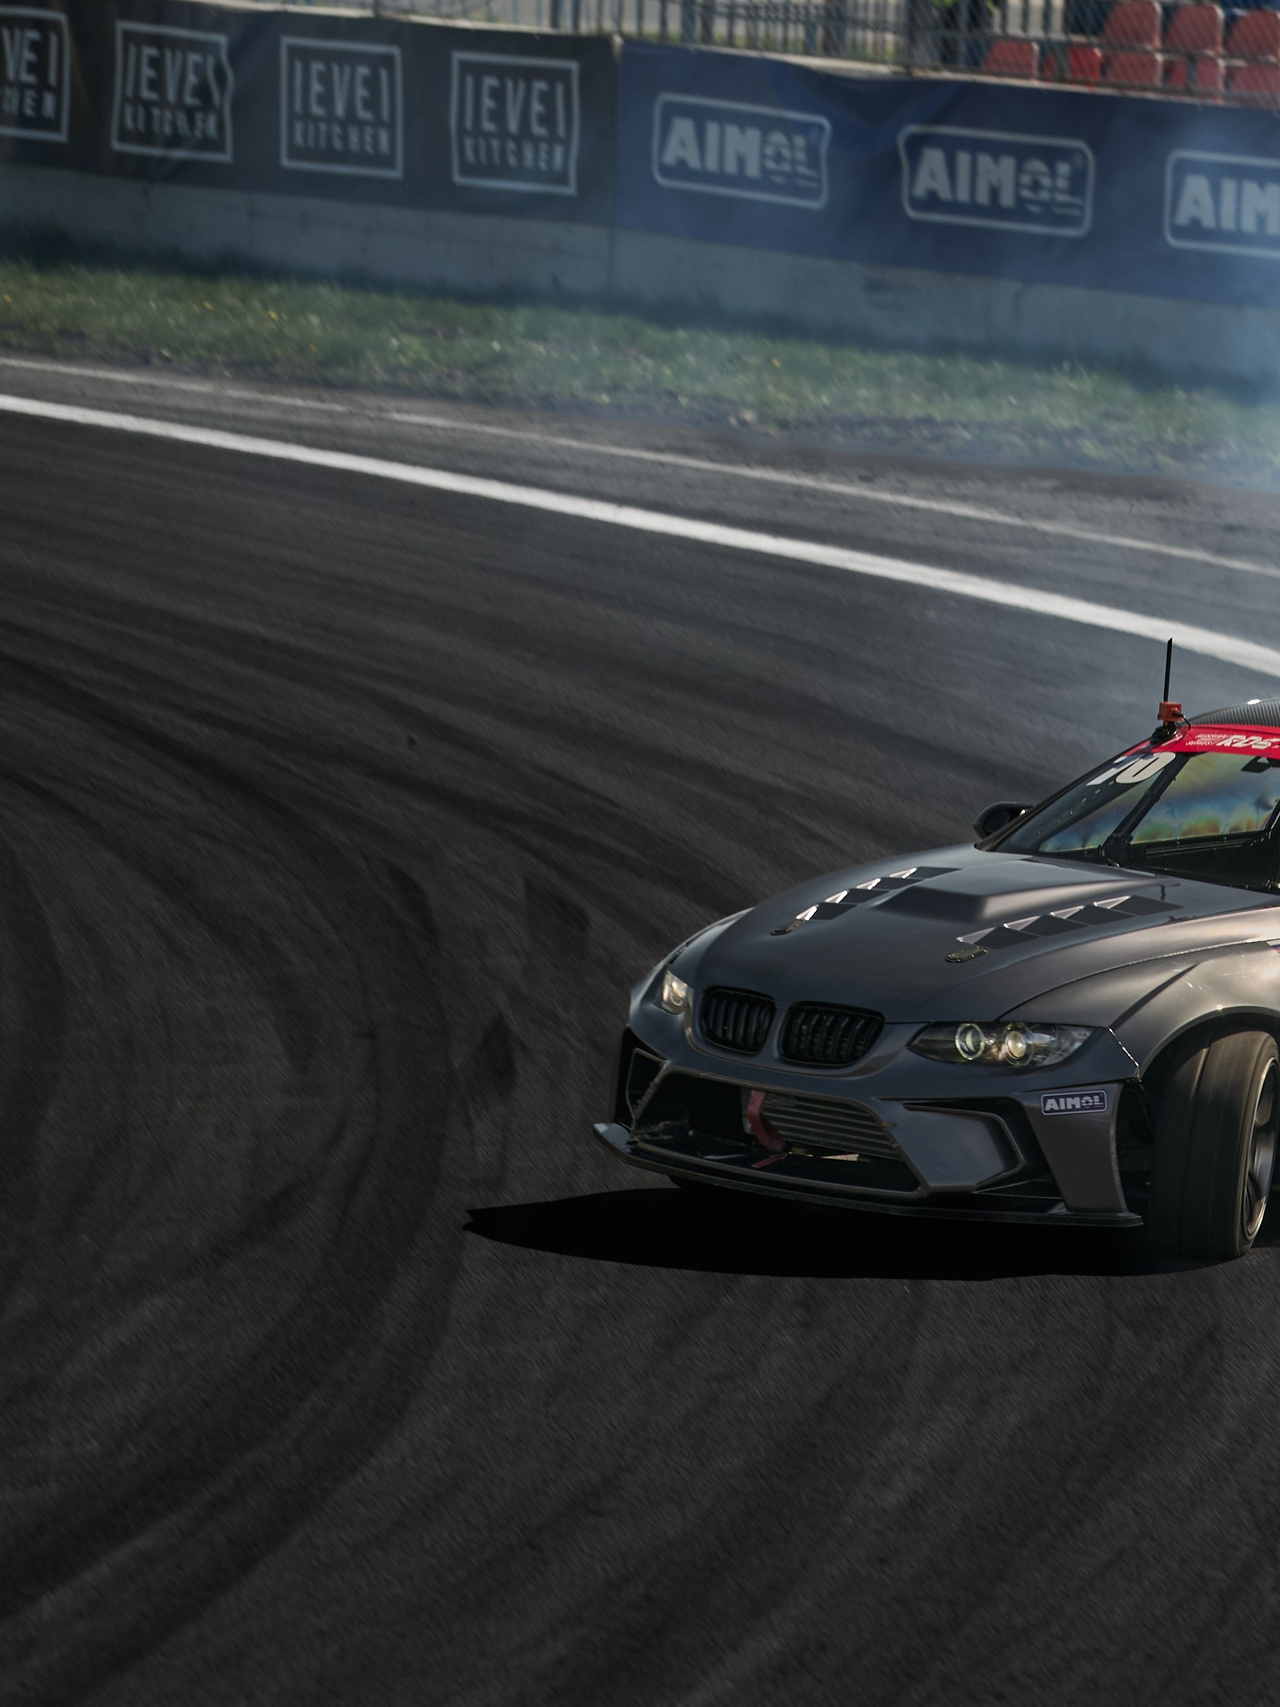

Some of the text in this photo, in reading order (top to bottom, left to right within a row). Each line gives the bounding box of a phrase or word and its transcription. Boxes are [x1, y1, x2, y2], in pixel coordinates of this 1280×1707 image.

[293, 119, 390, 156] KITCHEN
[463, 135, 564, 173] KITCHEN
[662, 115, 819, 189] AIMOL
[912, 146, 1084, 217] AIMOL
[1044, 1095, 1104, 1111] AIMOL
